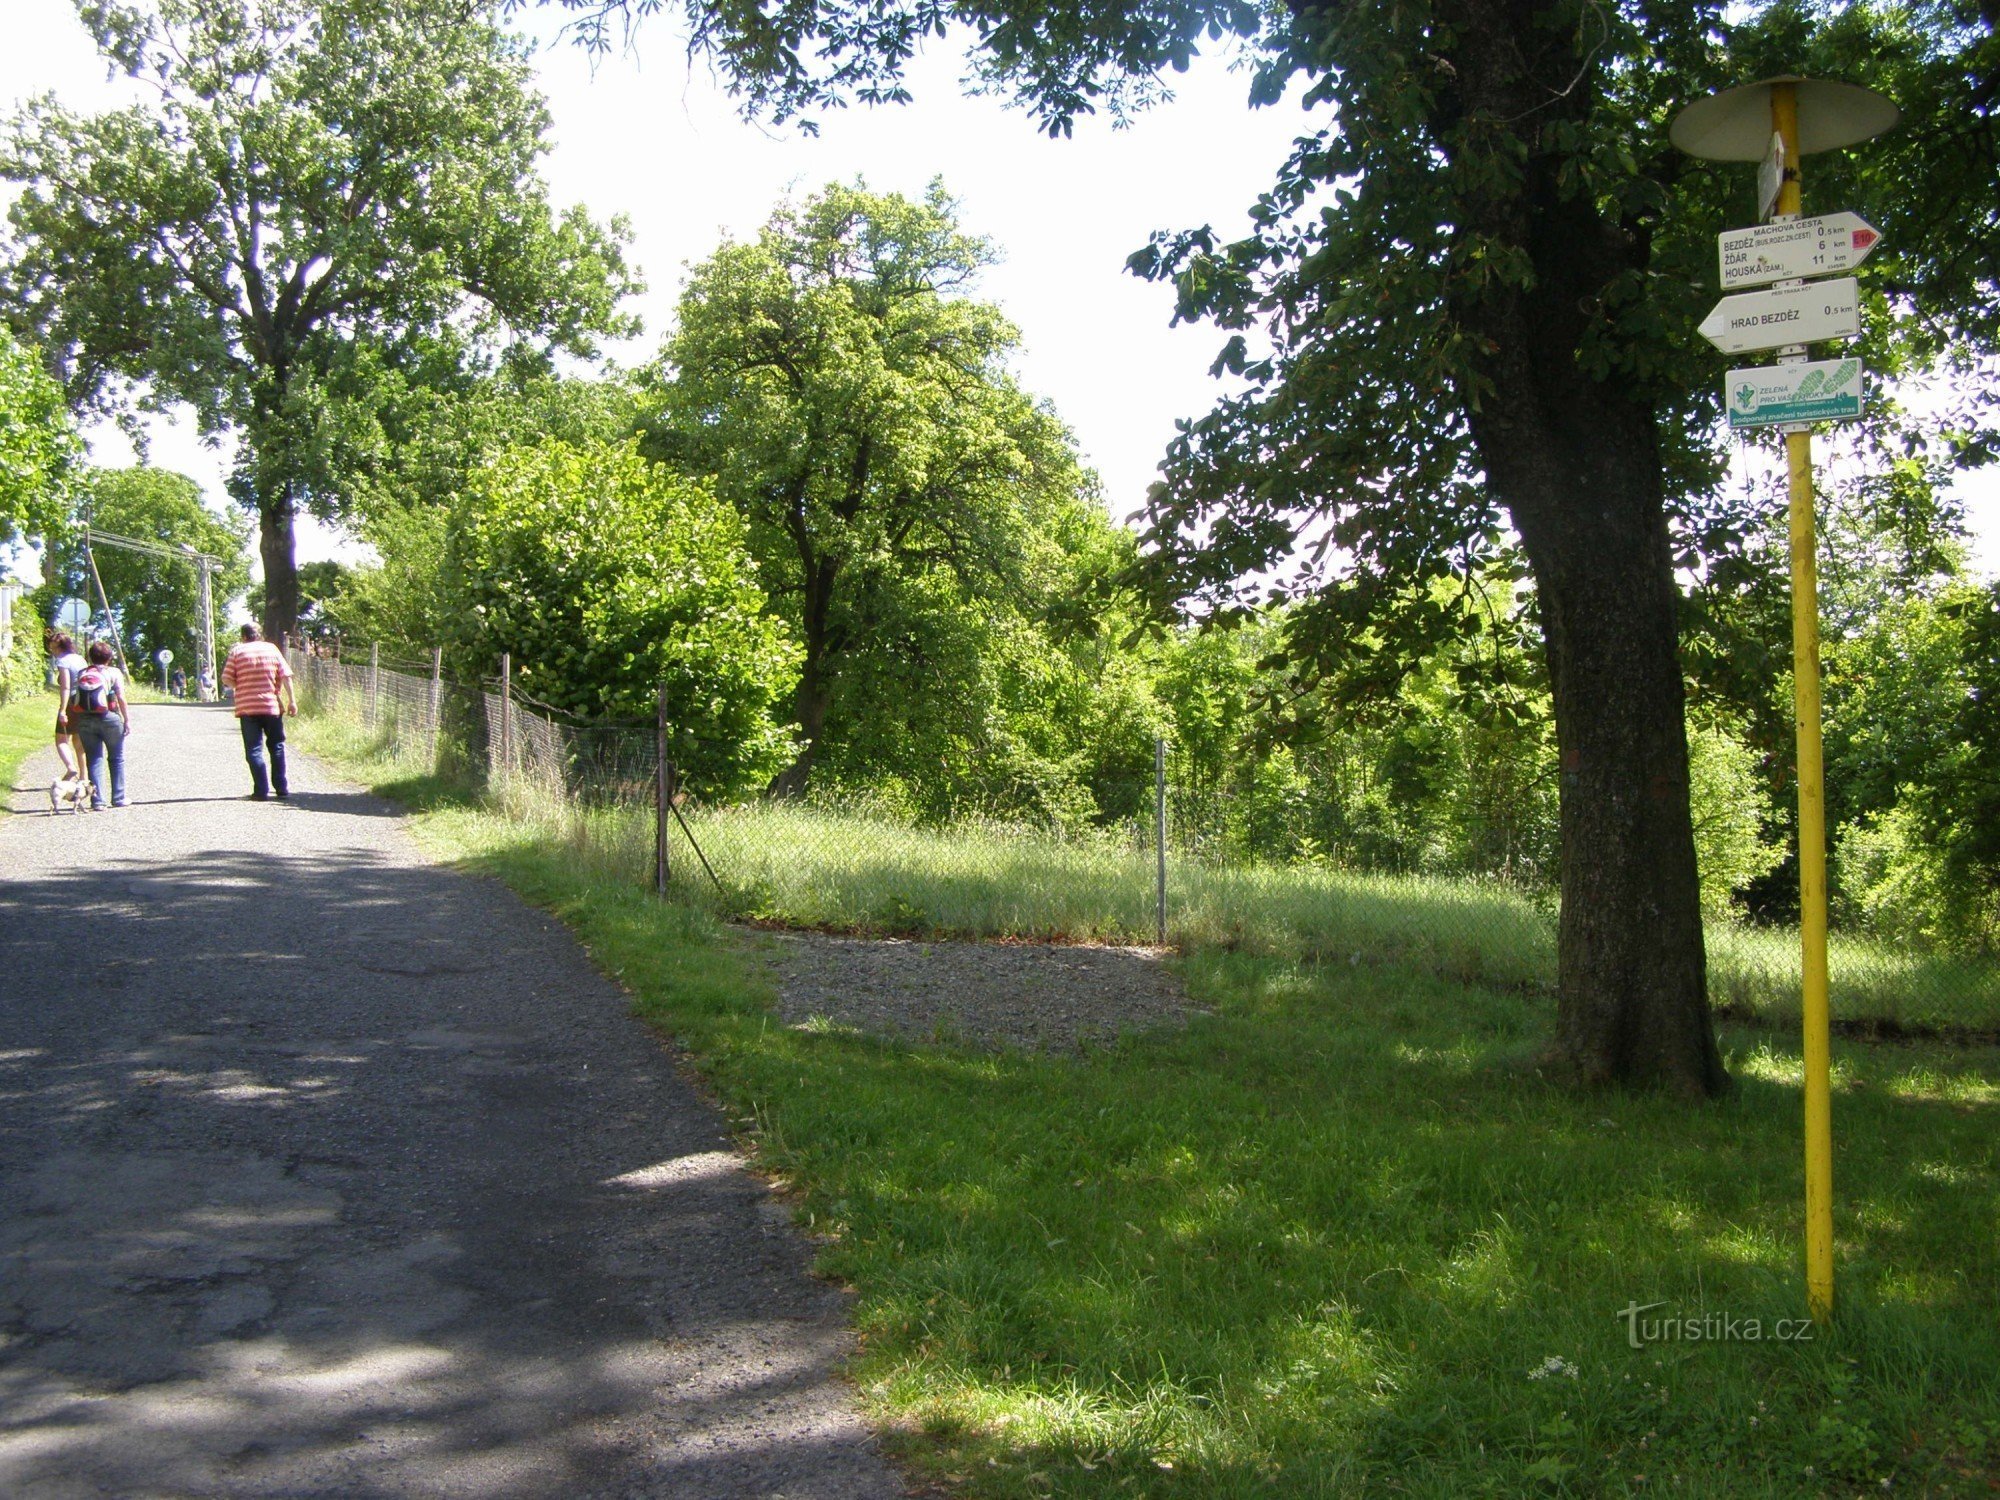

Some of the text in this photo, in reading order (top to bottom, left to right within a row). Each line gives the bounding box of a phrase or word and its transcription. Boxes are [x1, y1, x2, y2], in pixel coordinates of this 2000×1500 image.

[1795, 219, 1823, 230] CESTA
[1724, 237, 1754, 252] BEZDĚZ
[1819, 240, 1825, 250] 6
[1725, 265, 1762, 279] HOUSKA
[1812, 255, 1824, 265] 11
[1731, 315, 1759, 329] HRAD
[1761, 309, 1800, 325] BEZDĚZ
[1840, 305, 1853, 313] km
[1760, 396, 1776, 404] PRO
[1797, 408, 1840, 418] turistických
[1841, 406, 1856, 414] tras
